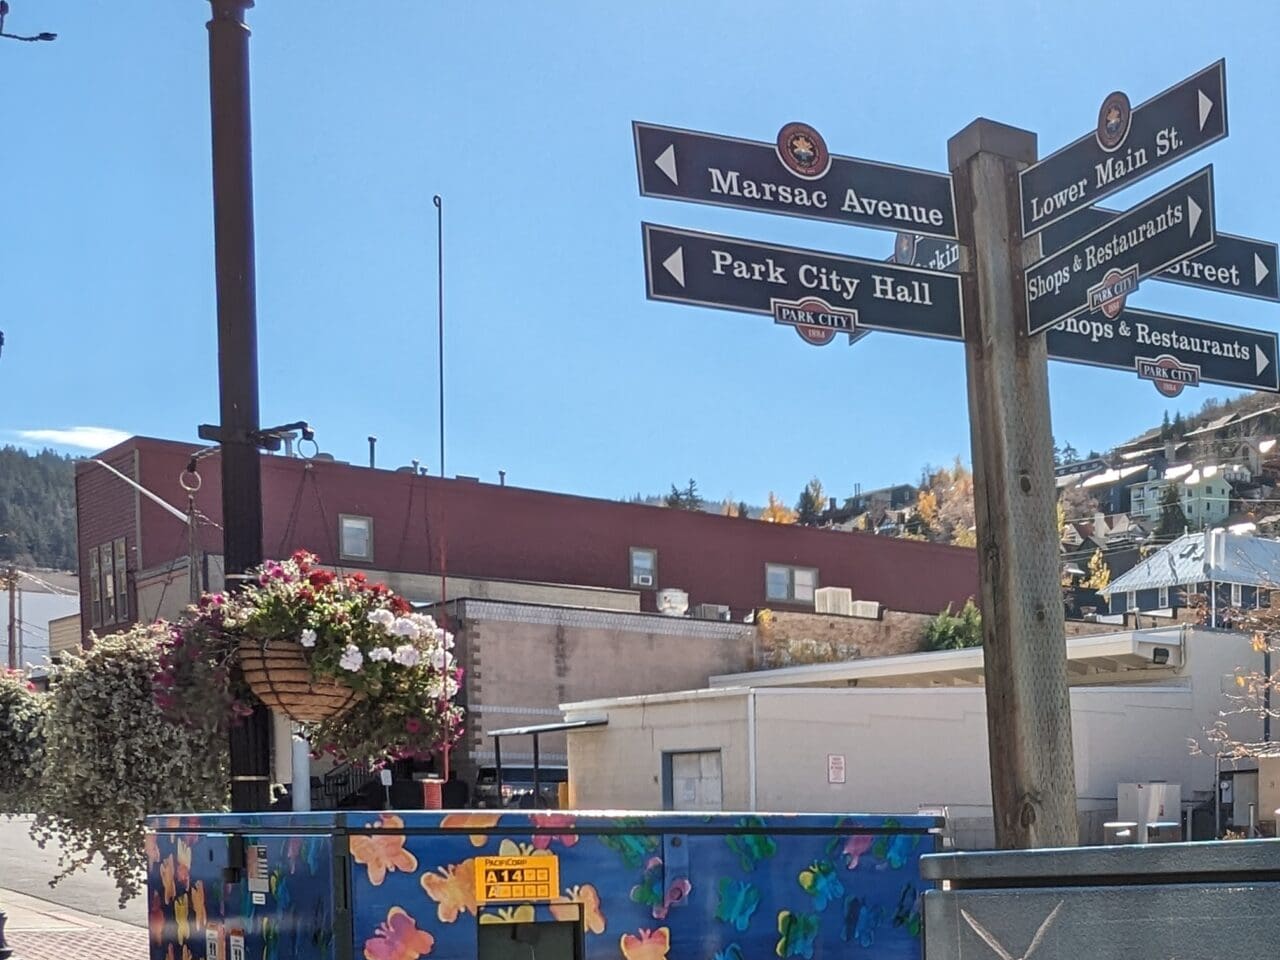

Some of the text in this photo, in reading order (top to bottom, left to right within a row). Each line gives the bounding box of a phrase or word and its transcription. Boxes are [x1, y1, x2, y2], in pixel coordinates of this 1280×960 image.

[1031, 126, 1184, 222] Lower Main St.
[708, 167, 944, 226] Marsac Avenue
[1028, 203, 1183, 301] Shops & Restaurants
[711, 250, 933, 305] Park City Hall
[1093, 275, 1134, 306] PARK CITY
[782, 308, 848, 328] PARK CITY
[1118, 320, 1131, 337] &
[1136, 322, 1250, 360] Restaurants
[1144, 365, 1193, 382] PARK CITY
[487, 869, 522, 883] A14
